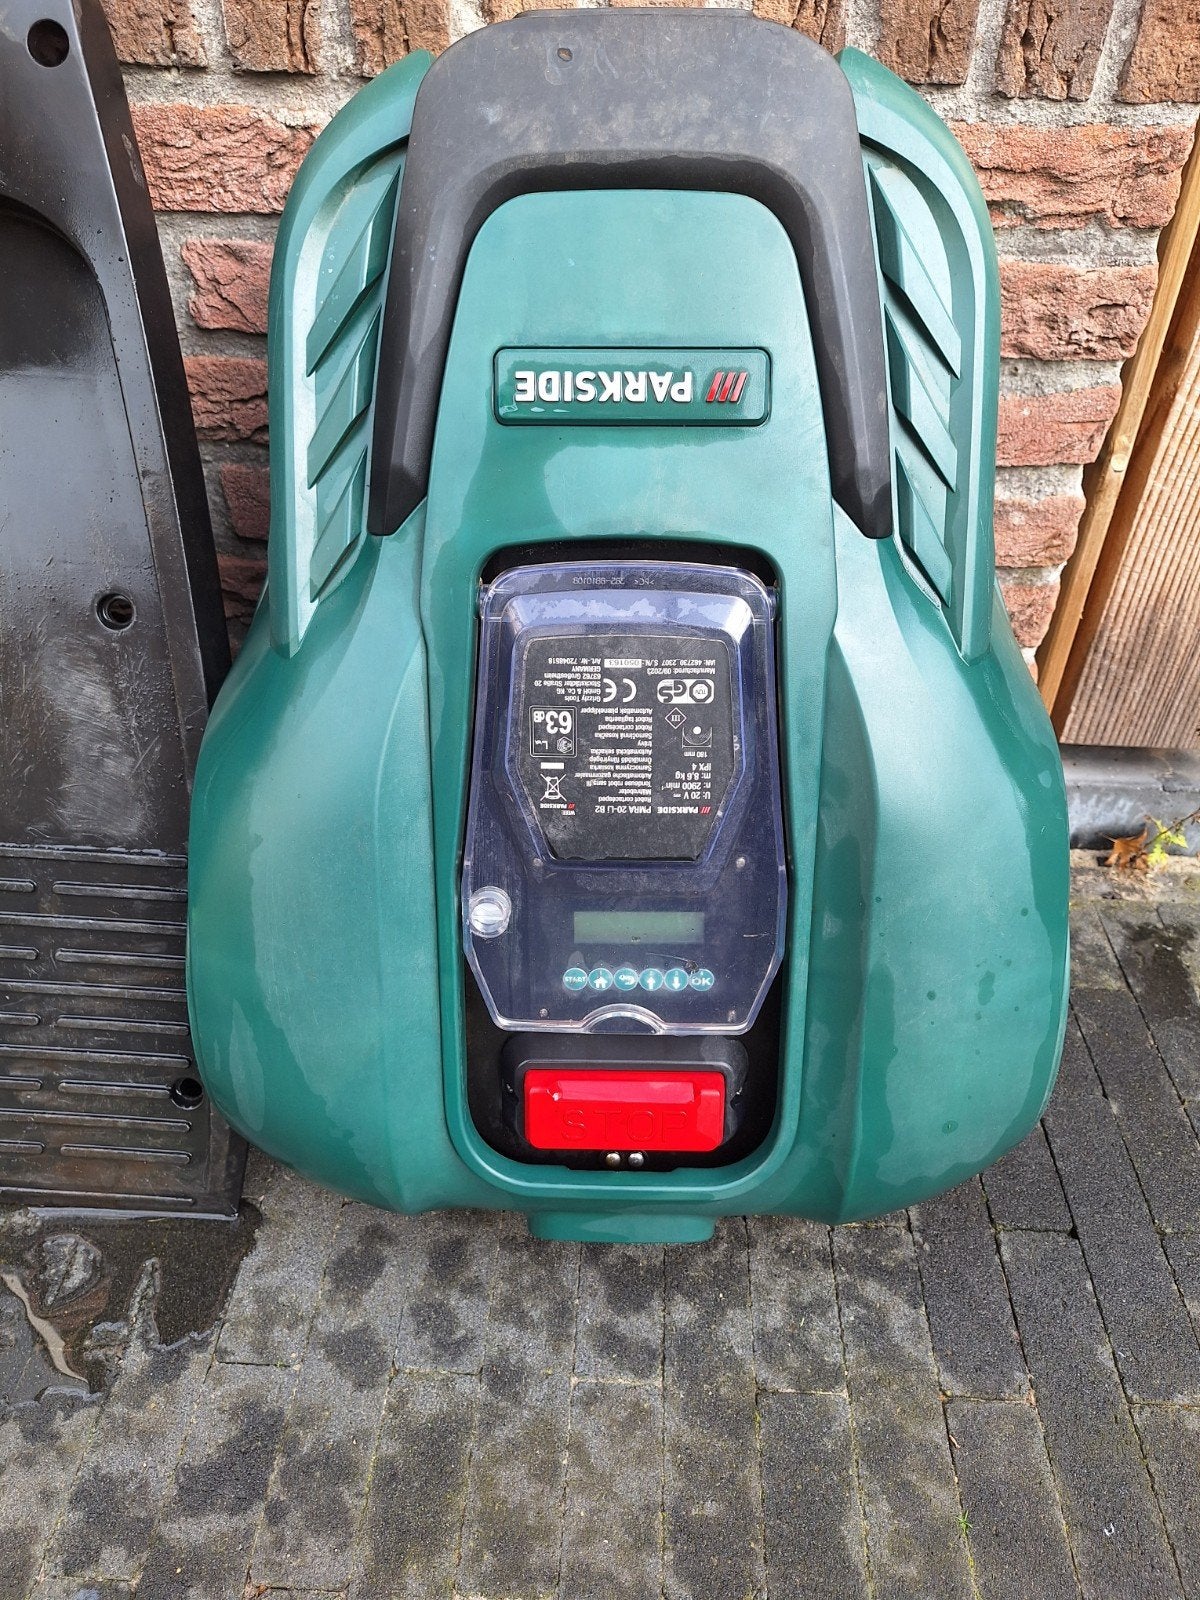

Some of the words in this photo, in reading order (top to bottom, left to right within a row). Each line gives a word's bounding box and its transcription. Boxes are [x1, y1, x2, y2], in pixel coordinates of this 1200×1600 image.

[514, 371, 693, 403] PARKSIDE
[534, 711, 545, 722] dB
[546, 711, 572, 734] 63
[675, 771, 685, 780] kg
[692, 977, 711, 986] OK
[561, 1109, 687, 1142] STOP
